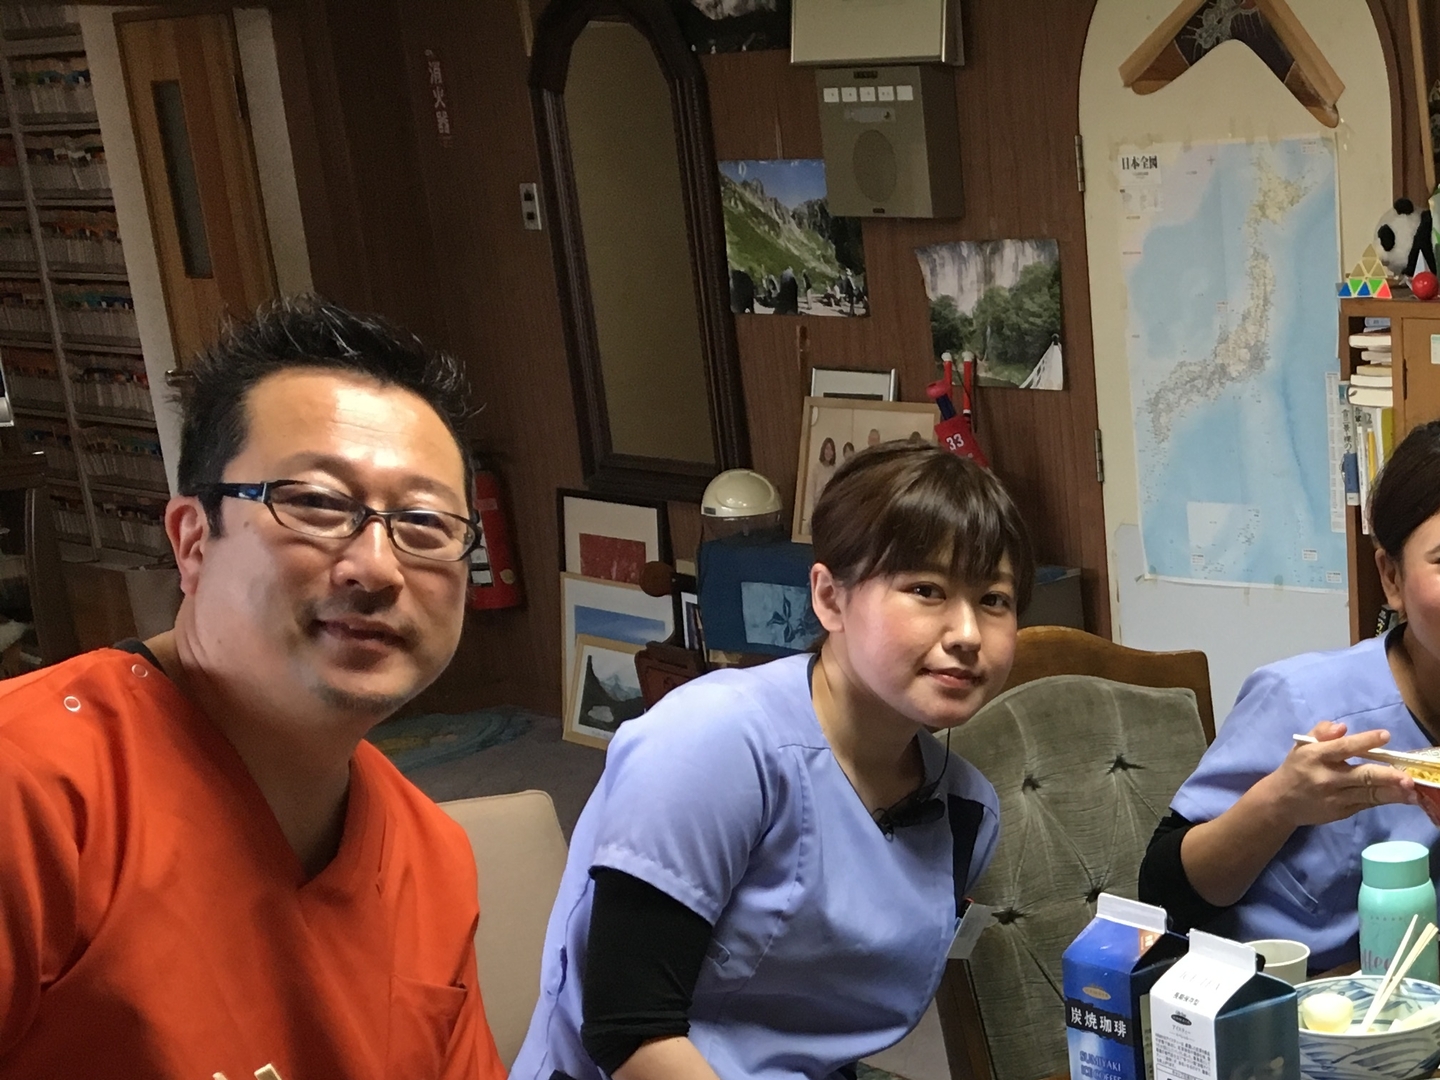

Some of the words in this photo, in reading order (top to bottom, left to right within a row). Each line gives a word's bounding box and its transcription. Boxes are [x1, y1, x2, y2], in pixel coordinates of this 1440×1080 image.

[428, 60, 451, 134] 消火器
[1121, 155, 1158, 171] 日本全図
[946, 433, 964, 451] 33
[1070, 1005, 1127, 1039] 炭焼珈琲
[1080, 1051, 1121, 1073] SUMIYAKI
